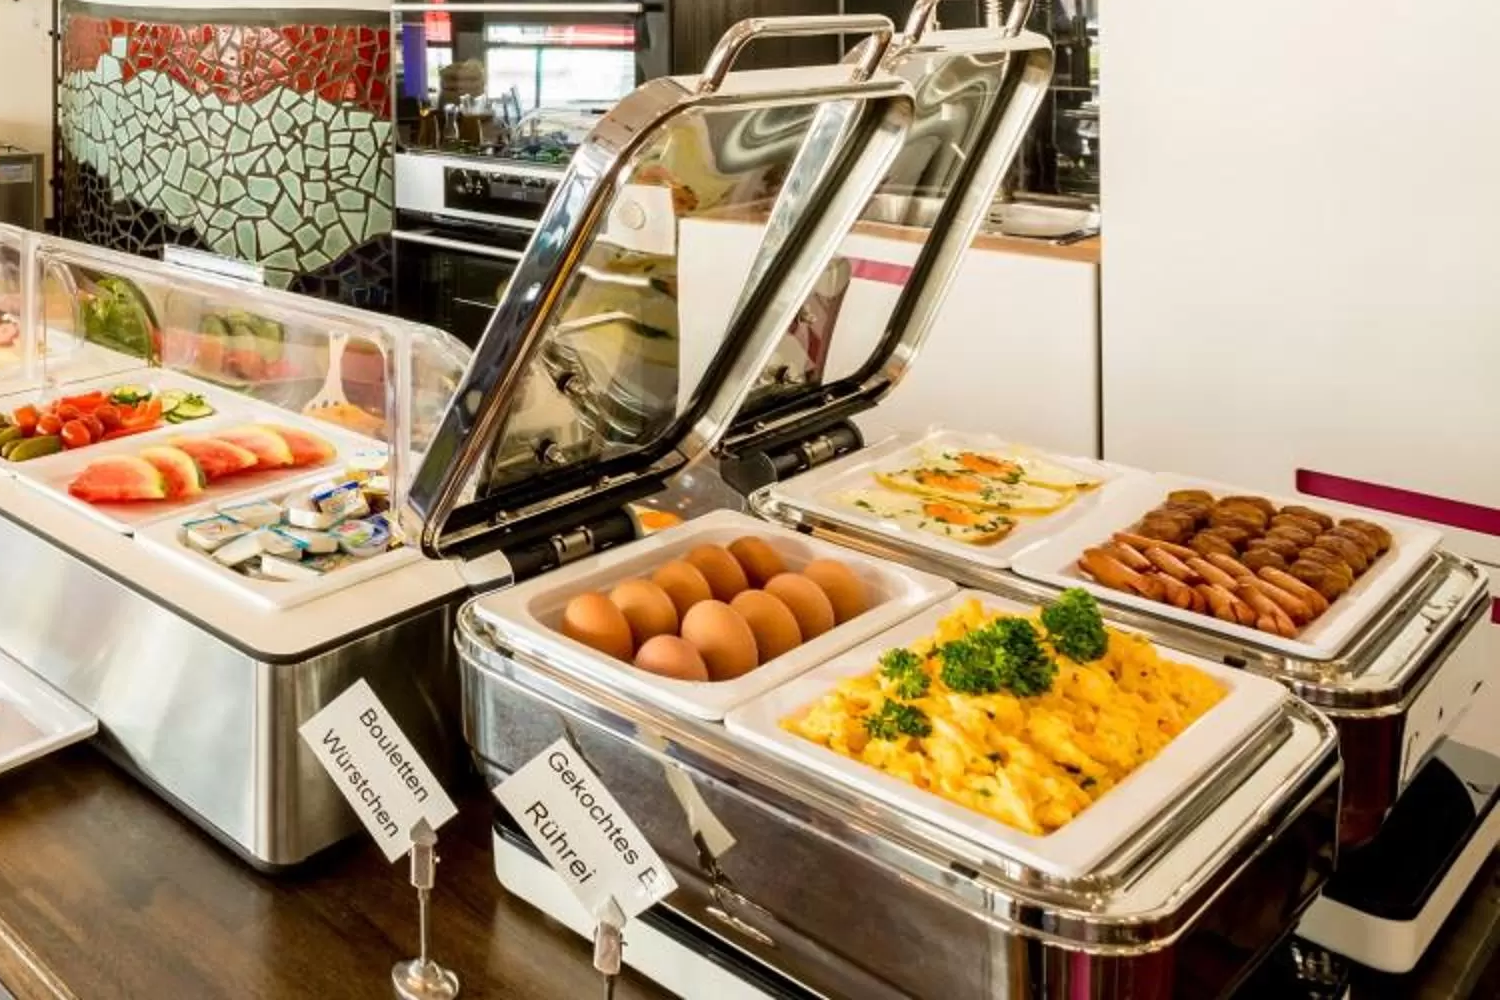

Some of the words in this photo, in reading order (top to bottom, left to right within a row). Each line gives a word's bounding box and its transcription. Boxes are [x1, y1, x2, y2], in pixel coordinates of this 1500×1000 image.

[322, 727, 401, 839] Würstchen
[359, 707, 430, 804] Bouletten
[525, 799, 598, 885] Rührei
[548, 751, 640, 866] Gekochtes
